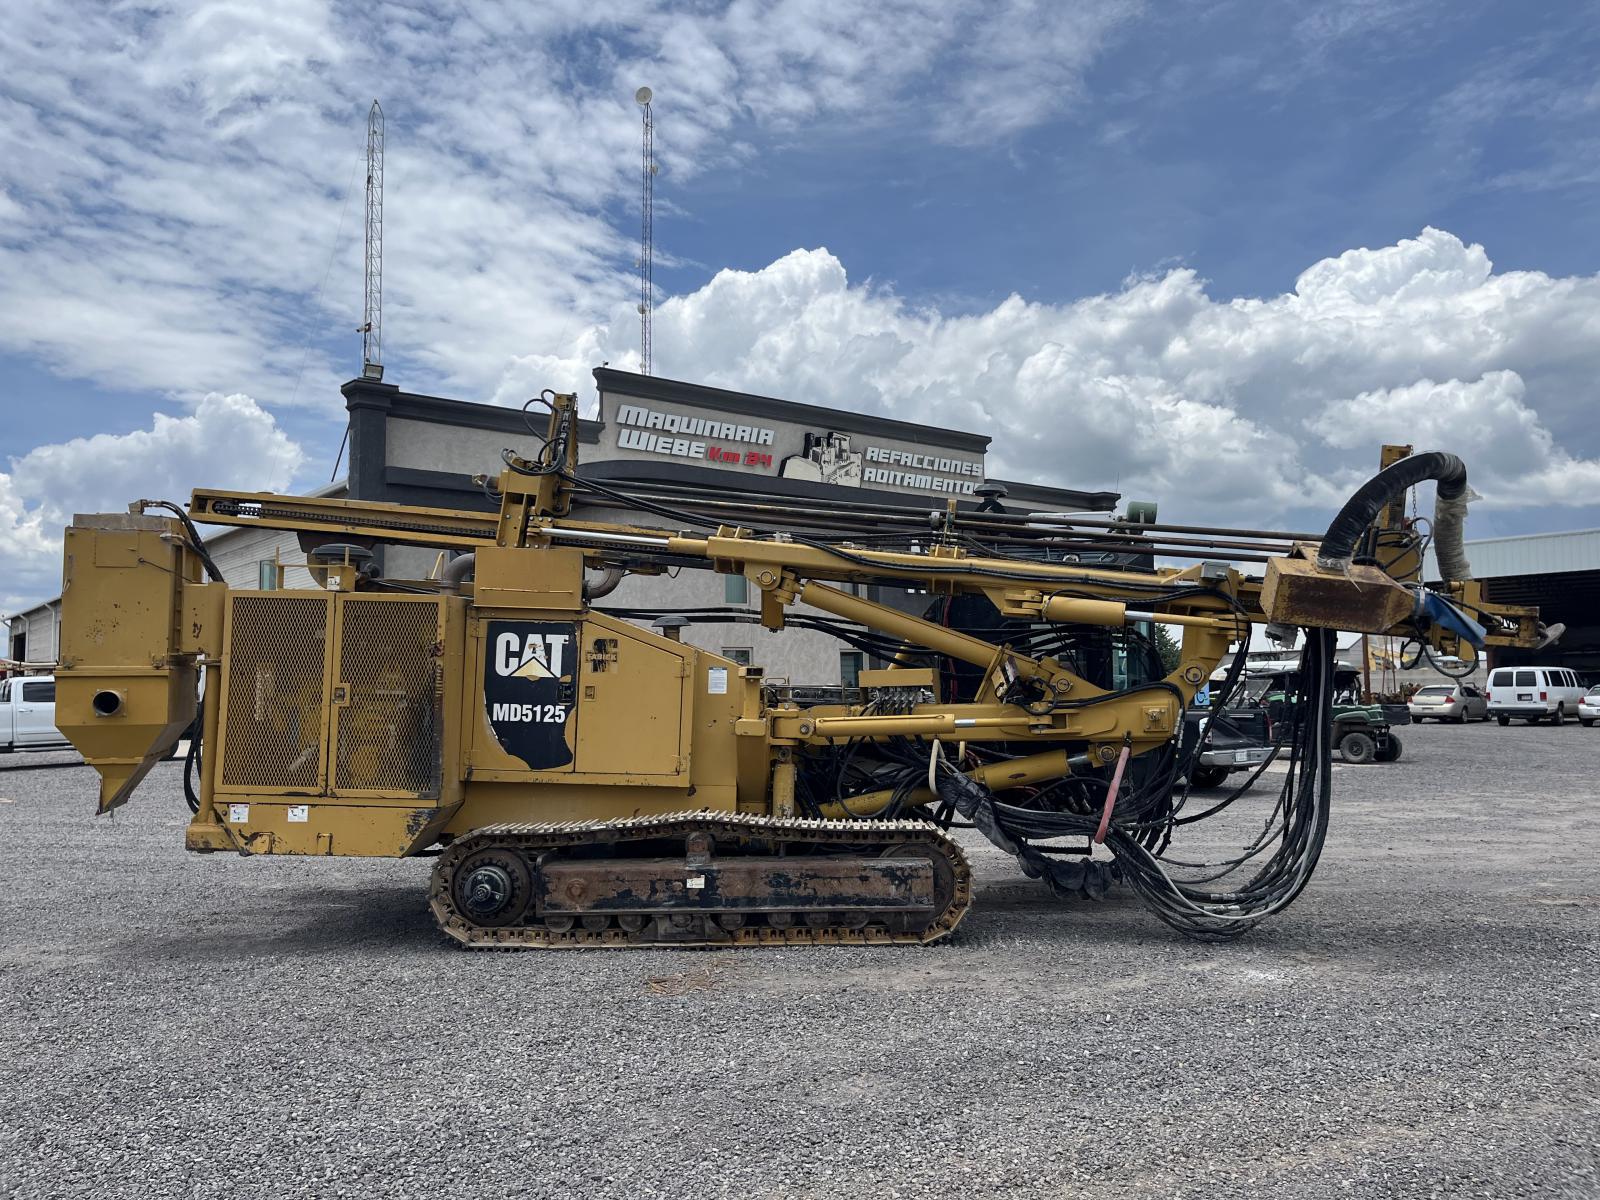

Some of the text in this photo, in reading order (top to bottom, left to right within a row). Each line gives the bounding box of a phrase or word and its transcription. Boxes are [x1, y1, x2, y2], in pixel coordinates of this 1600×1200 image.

[616, 404, 775, 446] MAQUINARIA
[618, 429, 773, 468] WIEBE Km 24
[865, 446, 983, 477] REFACCIONES
[495, 632, 569, 678] CAT
[493, 703, 566, 724] MD5125
